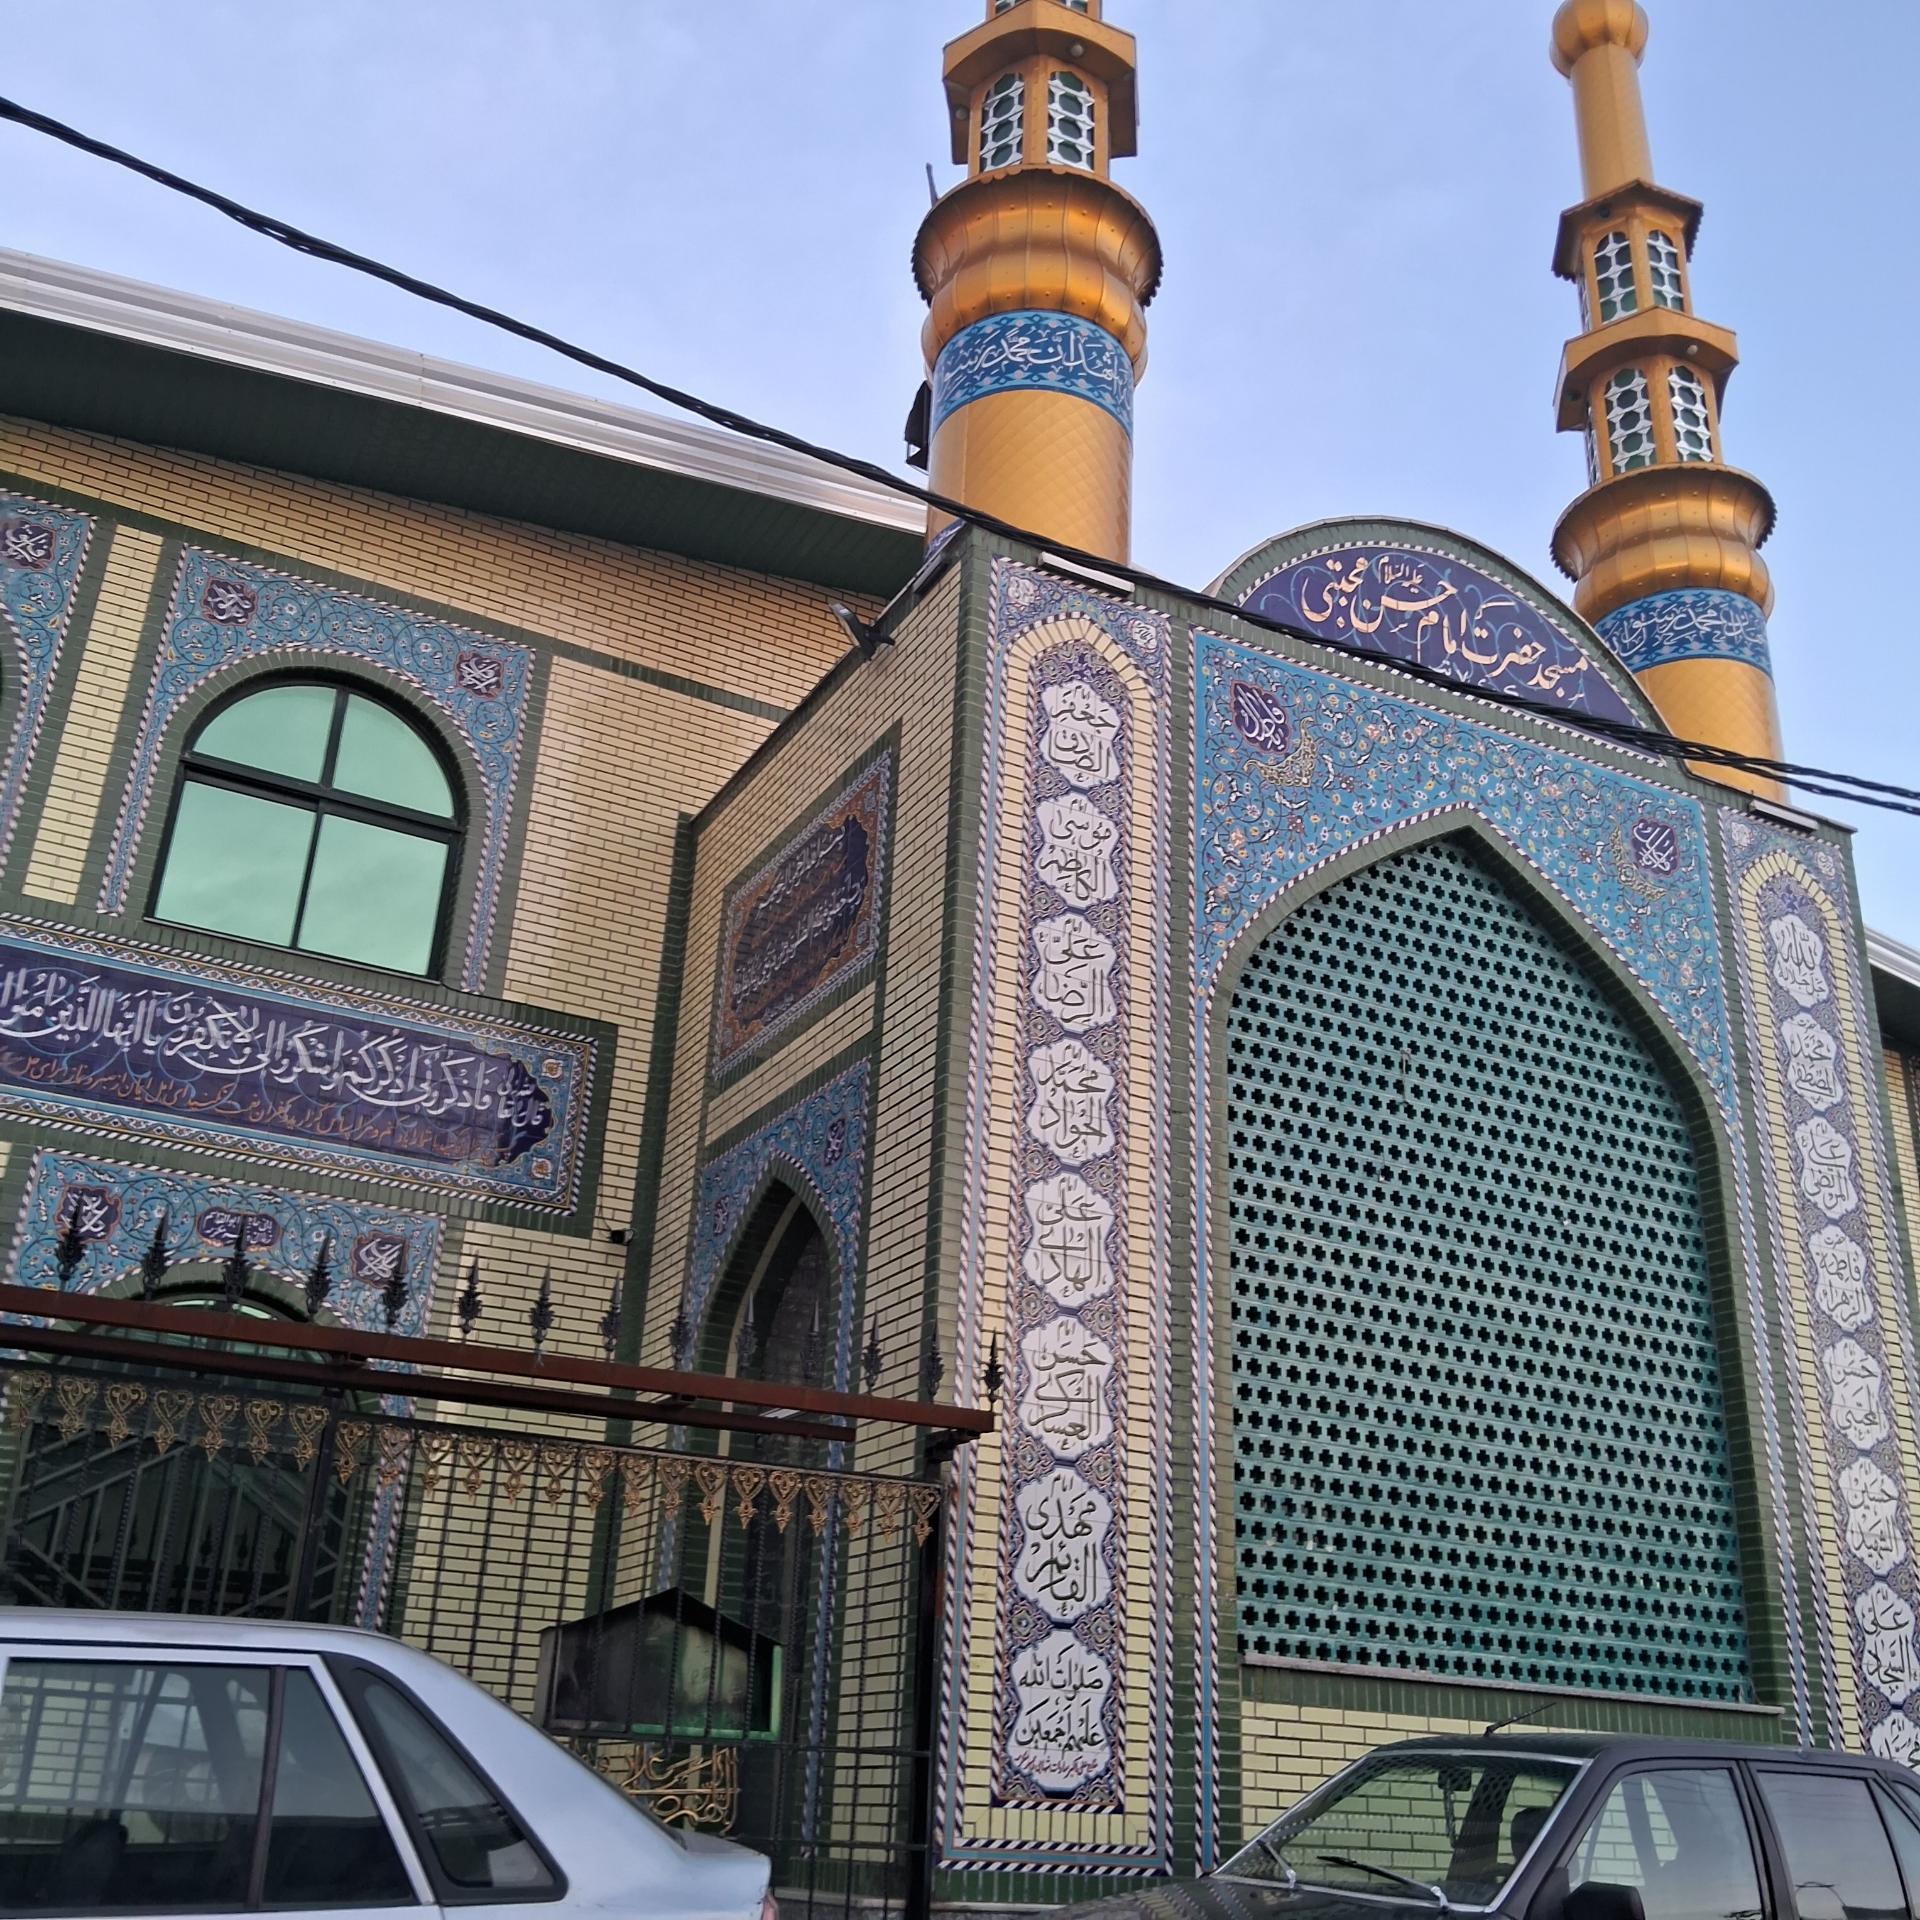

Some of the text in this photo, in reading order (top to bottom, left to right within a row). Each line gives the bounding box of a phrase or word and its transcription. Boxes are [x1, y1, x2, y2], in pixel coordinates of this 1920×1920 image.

[1378, 555, 1410, 585] السلام
[1301, 556, 1369, 629] مجتبی
[1351, 580, 1459, 633] حسن
[1417, 608, 1468, 664] امام
[1462, 626, 1548, 679] حضرت
[1073, 685, 1091, 701] امام
[1527, 656, 1589, 698] مسجد
[1050, 699, 1117, 733] جعفر
[1048, 728, 1112, 780] الصادق
[1070, 799, 1088, 814] امام
[1039, 851, 1108, 901] الکاظم
[1064, 918, 1083, 934] امام
[1776, 920, 1817, 971] الله
[1044, 930, 1106, 965] علی
[1043, 966, 1105, 1024] الرضا
[1064, 1043, 1083, 1061] امام
[1790, 1034, 1833, 1062] محمد
[1037, 1058, 1107, 1094] محمد
[1039, 1096, 1109, 1150] الجواد
[1058, 1175, 1078, 1193] امام
[1036, 1189, 1103, 1226] علی
[1037, 1224, 1103, 1292] الهادی
[1057, 1319, 1077, 1342] امام
[1032, 1345, 1108, 1371] حسن
[1050, 1474, 1074, 1499] امام
[1025, 1495, 1098, 1541] مهدی
[1861, 1594, 1910, 1636] علی
[1019, 1654, 1104, 1702] صلوات الله
[1015, 1704, 1105, 1756] علیهم اجمعین
